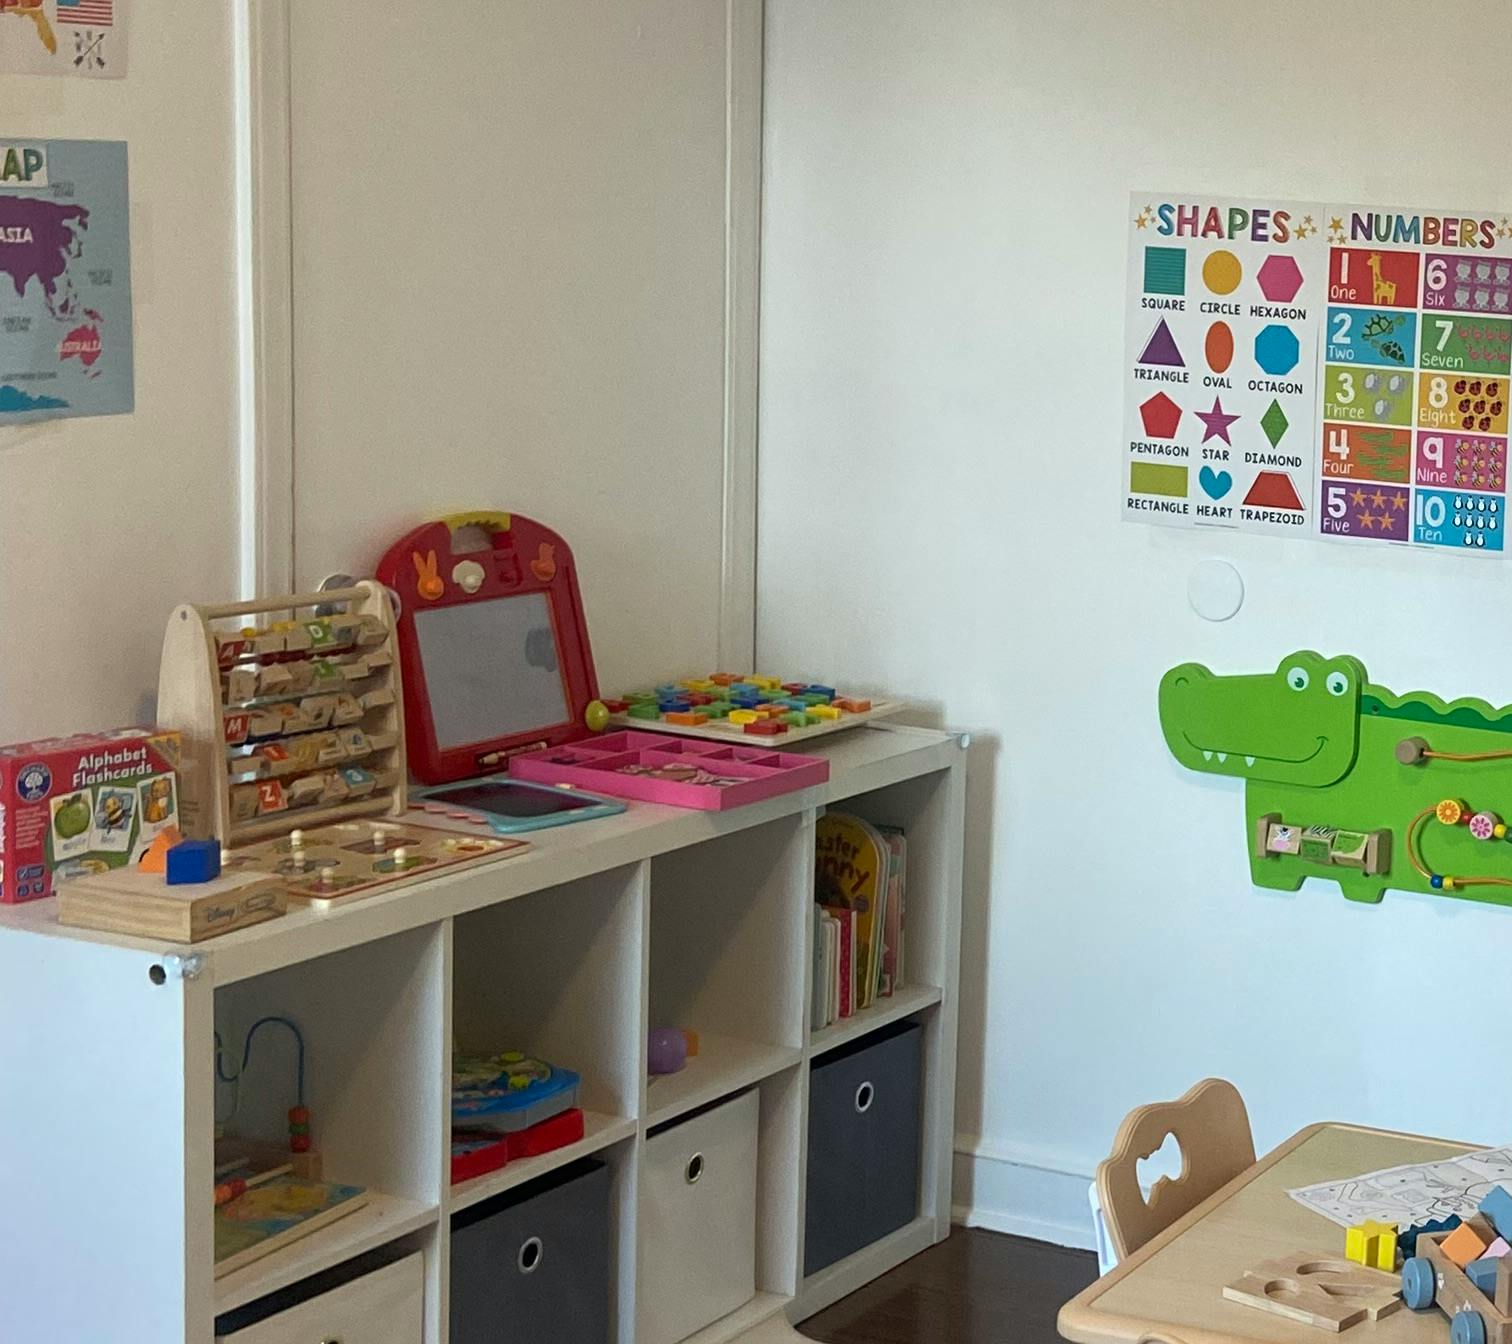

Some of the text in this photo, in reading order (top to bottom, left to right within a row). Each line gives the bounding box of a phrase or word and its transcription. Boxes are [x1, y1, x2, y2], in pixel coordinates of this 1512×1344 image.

[0, 148, 43, 181] AP
[1157, 204, 1291, 243] SHAPES
[1351, 212, 1496, 249] NUMBERS
[1341, 252, 1349, 284] 1
[1427, 259, 1448, 290] 6
[1331, 285, 1357, 300] One
[1142, 298, 1185, 311] SQUARE
[1200, 302, 1241, 315] CIRCLE
[1250, 306, 1307, 320] HEXAGON
[1332, 313, 1353, 344] 2
[1435, 320, 1454, 352] 7
[1328, 345, 1355, 361] Two
[1422, 353, 1464, 369] Seven
[1134, 369, 1189, 383] TRIANGLE
[1203, 377, 1232, 388] OVAL
[1248, 380, 1303, 394] OCTAGON
[1336, 372, 1355, 404] 3
[1428, 377, 1448, 408] 8
[1326, 403, 1365, 419] Three
[1130, 442, 1189, 457] PENTAGON
[1329, 428, 1350, 460] 4
[1202, 449, 1229, 461] STAR
[1245, 453, 1302, 467] DIAMOND
[1423, 437, 1444, 469] 9
[1323, 460, 1354, 475] Four
[1127, 498, 1189, 514] RECTANGLE
[1327, 486, 1347, 518] 5
[1197, 506, 1233, 518] HEART
[1240, 509, 1305, 525] TRAPEZOID
[1416, 494, 1446, 527] 10
[1418, 527, 1443, 541] Ten
[78, 746, 147, 770] Alphabet
[72, 762, 152, 788] Flashcards
